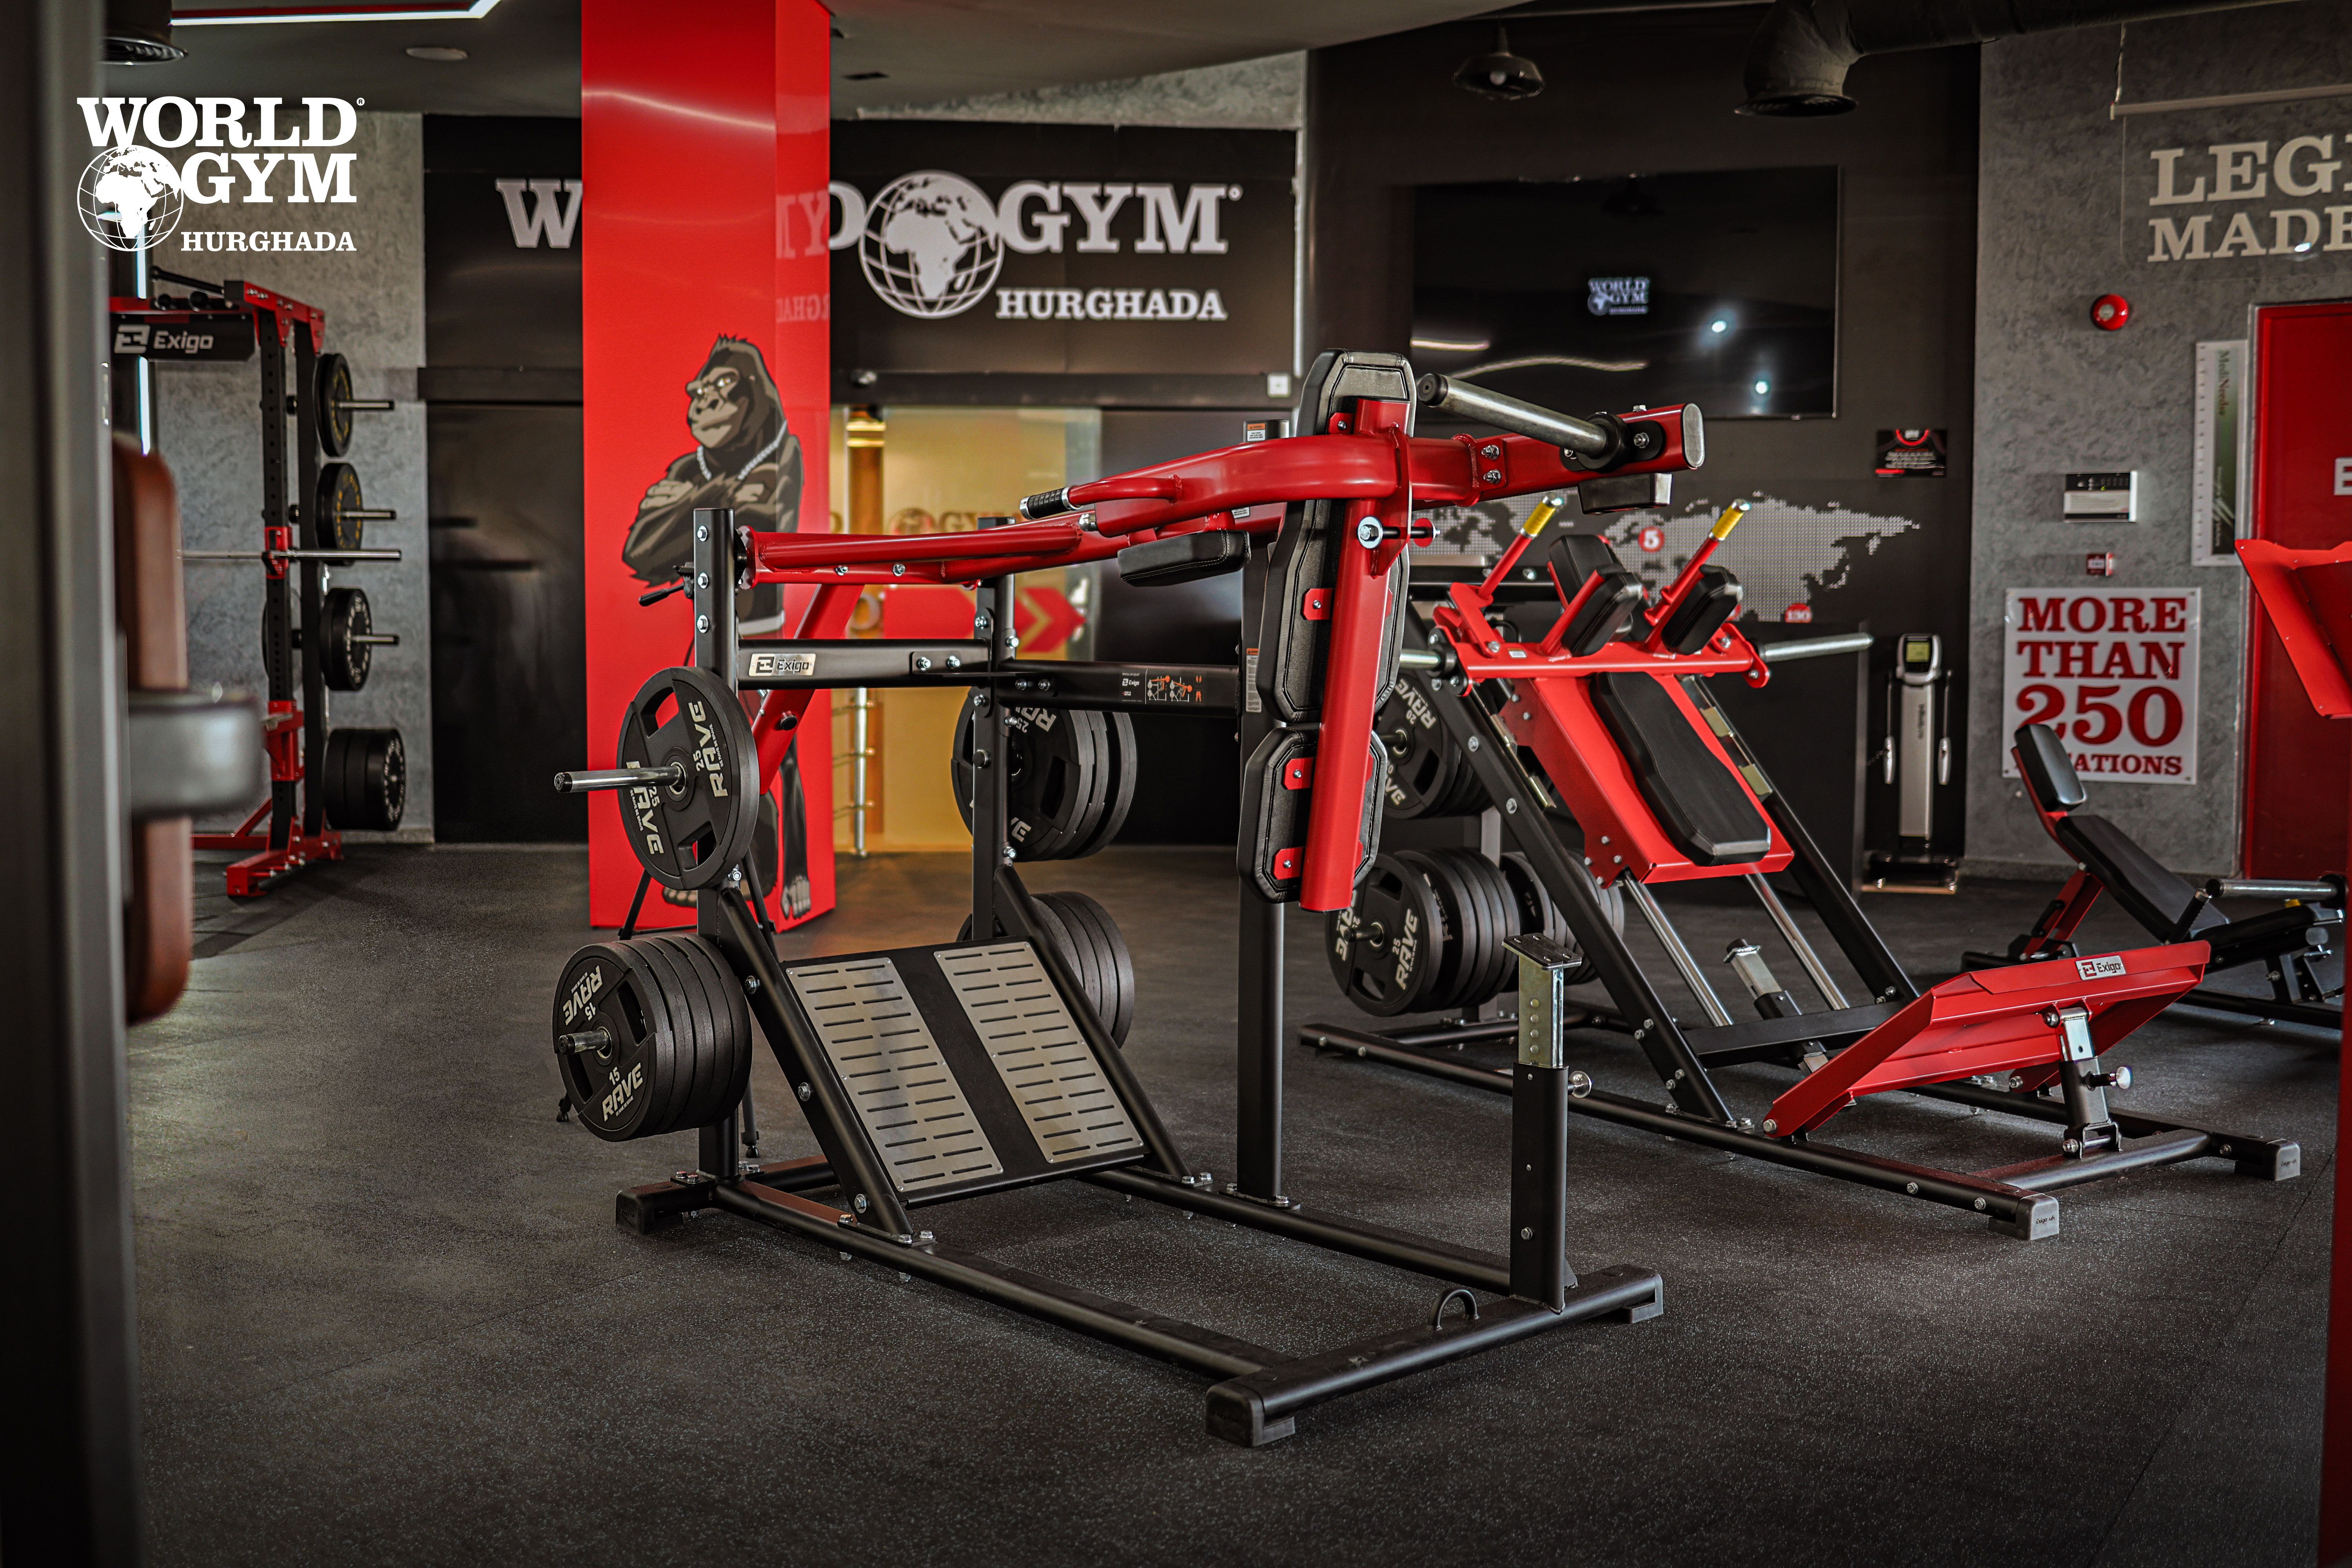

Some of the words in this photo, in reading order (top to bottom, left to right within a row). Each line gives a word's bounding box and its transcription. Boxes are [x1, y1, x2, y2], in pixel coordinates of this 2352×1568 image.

[2149, 134, 2352, 205] LEG
[997, 180, 1228, 254] GYM
[1588, 279, 1648, 292] WORLD
[996, 288, 1228, 320] HURGHADA
[153, 330, 214, 354] Exigo
[2017, 596, 2187, 633] MORE
[777, 659, 809, 673] Exigo
[2016, 641, 2185, 680] THAN
[1395, 679, 1436, 729] RAVE
[1406, 710, 1417, 724] 20
[2015, 684, 2183, 747] 250
[688, 701, 728, 797] RAVE
[693, 750, 705, 771] 25
[2069, 753, 2183, 776] ATIONS
[626, 760, 664, 855] AVE
[1392, 938, 1401, 955] 25
[1396, 908, 1418, 991] RAVE
[2096, 962, 2121, 973] Exigo
[563, 965, 603, 1026] RAVE
[585, 1002, 596, 1021] 15
[602, 1062, 643, 1122] RAVE
[609, 1066, 621, 1085] 15
